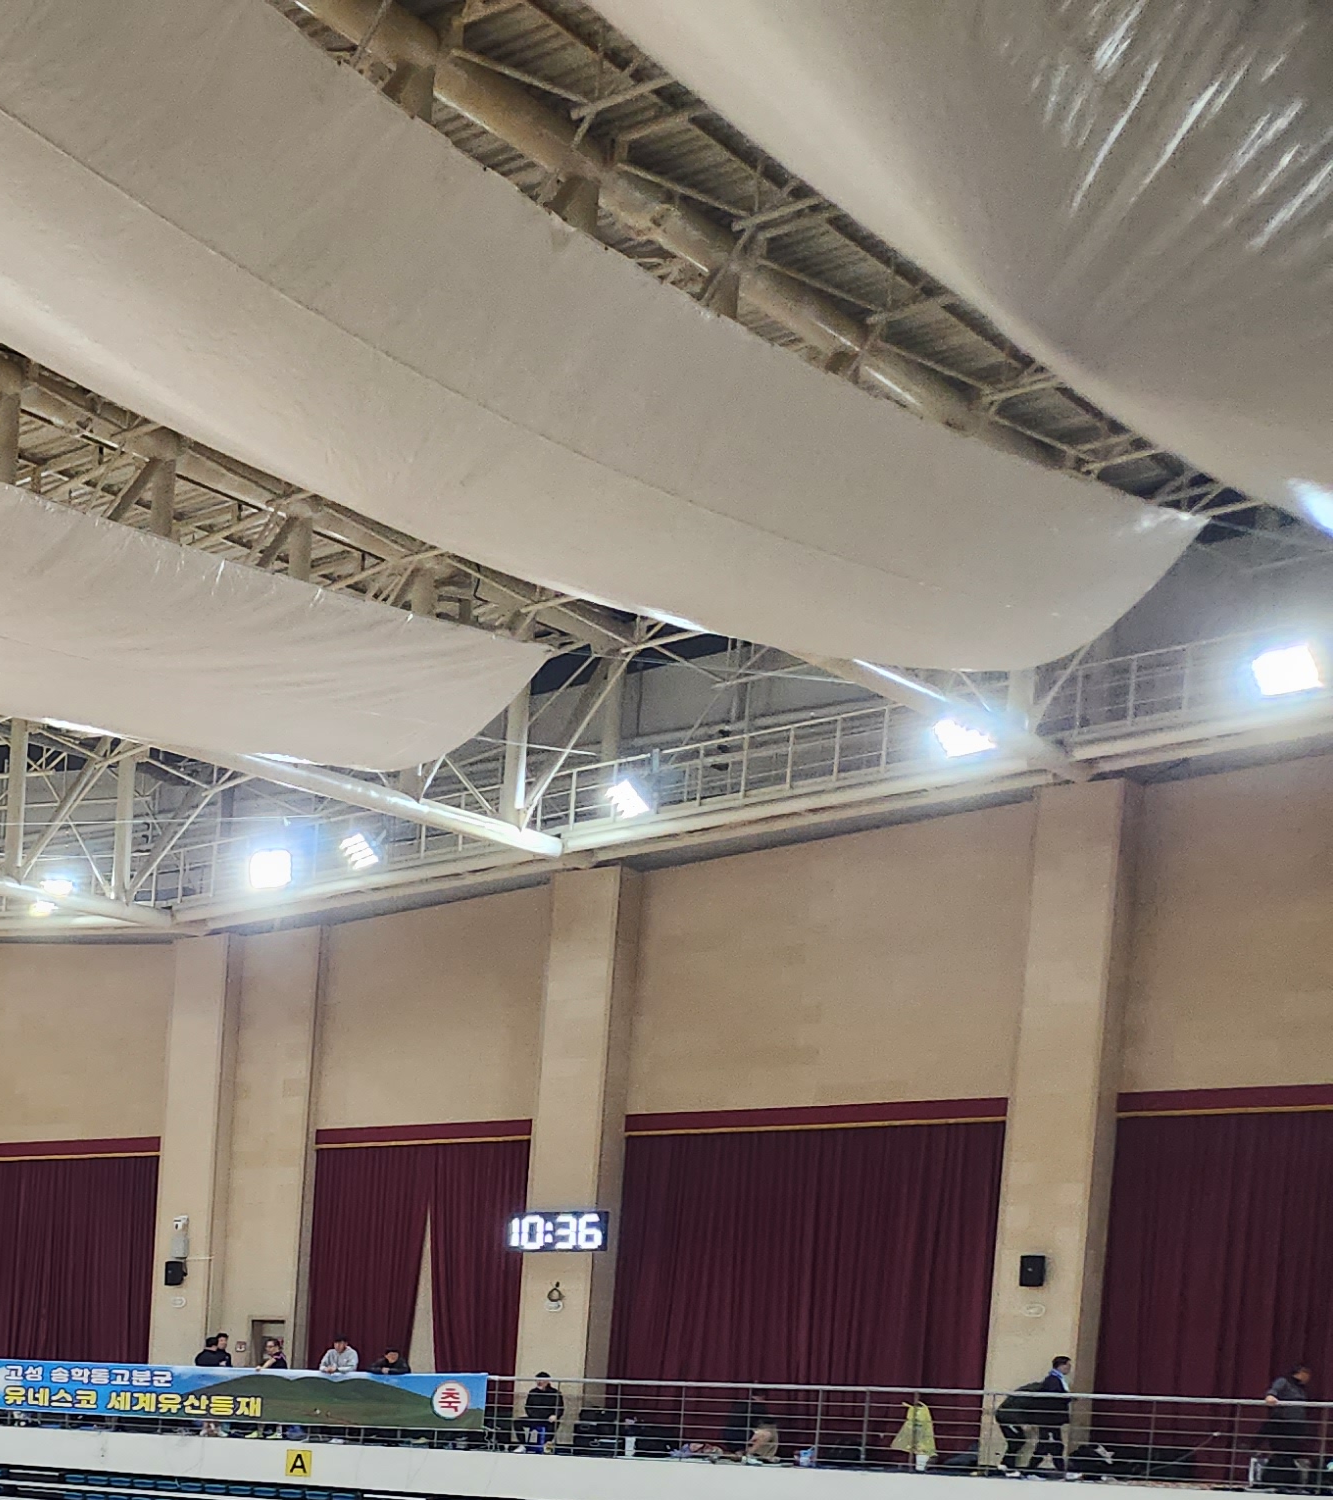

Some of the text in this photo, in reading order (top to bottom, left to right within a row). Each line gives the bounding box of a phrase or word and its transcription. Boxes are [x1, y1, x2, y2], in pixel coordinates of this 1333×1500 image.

[509, 1214, 603, 1250] 10:36
[5, 1365, 173, 1391] 고성 송학동고분군
[4, 1386, 263, 1417] 유네스코 세계유산등재
[289, 1453, 307, 1474] A
